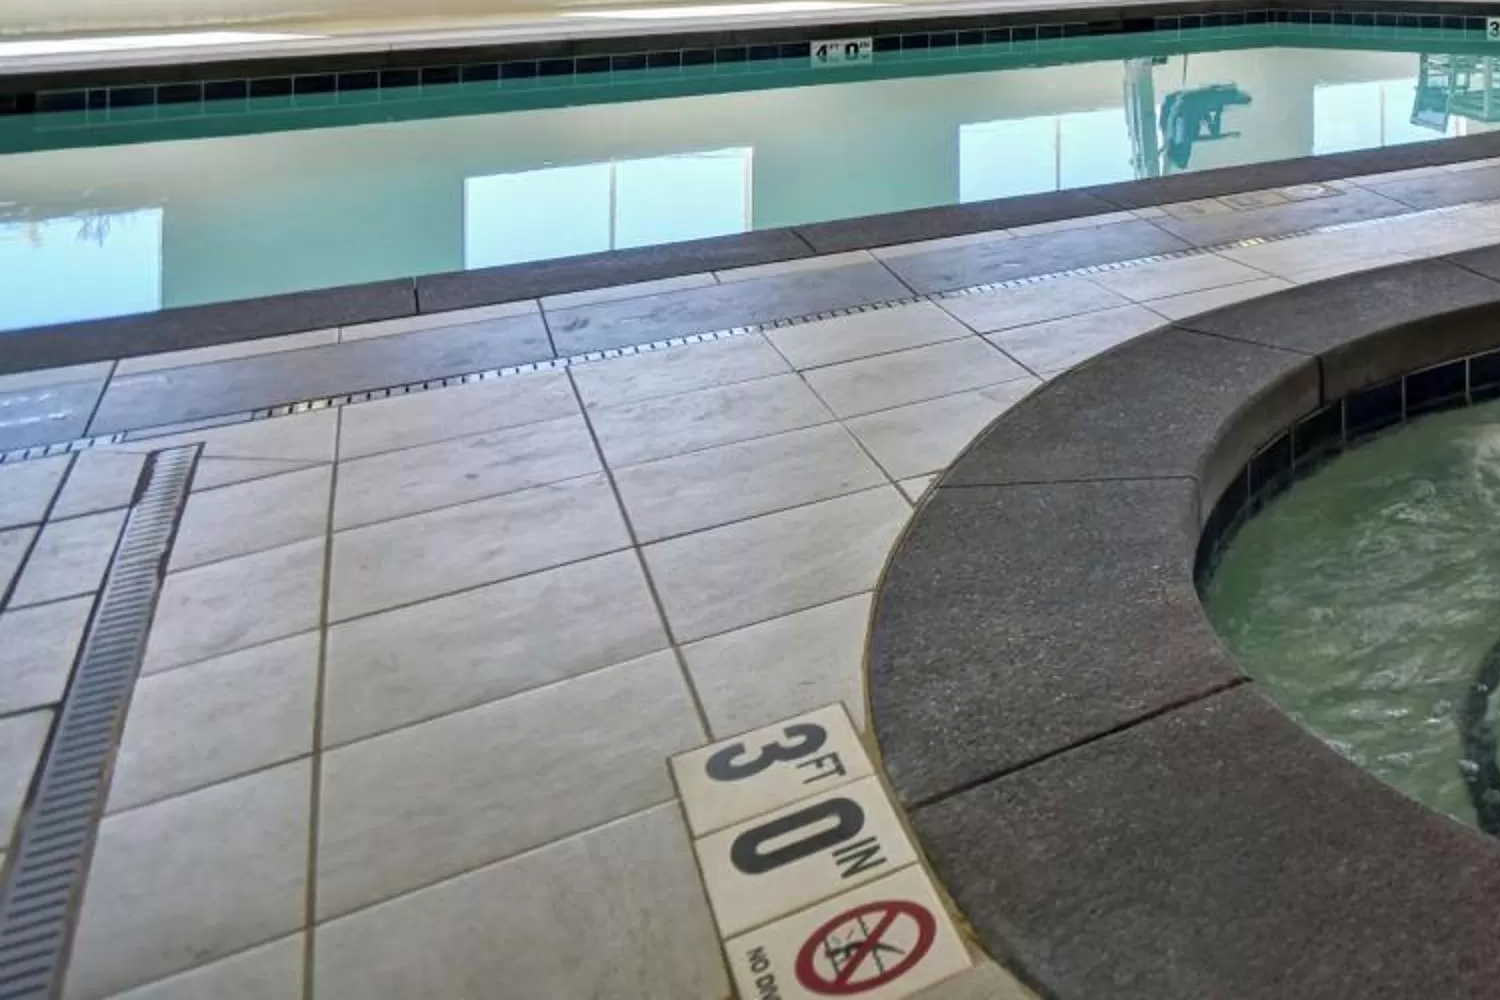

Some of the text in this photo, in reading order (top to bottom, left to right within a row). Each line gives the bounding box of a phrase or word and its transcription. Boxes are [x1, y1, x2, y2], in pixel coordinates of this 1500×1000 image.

[1489, 21, 1500, 37] 3
[815, 43, 828, 63] 4
[704, 722, 846, 785] 3 FT
[730, 796, 888, 879] 0 IN
[745, 945, 771, 974] NO
